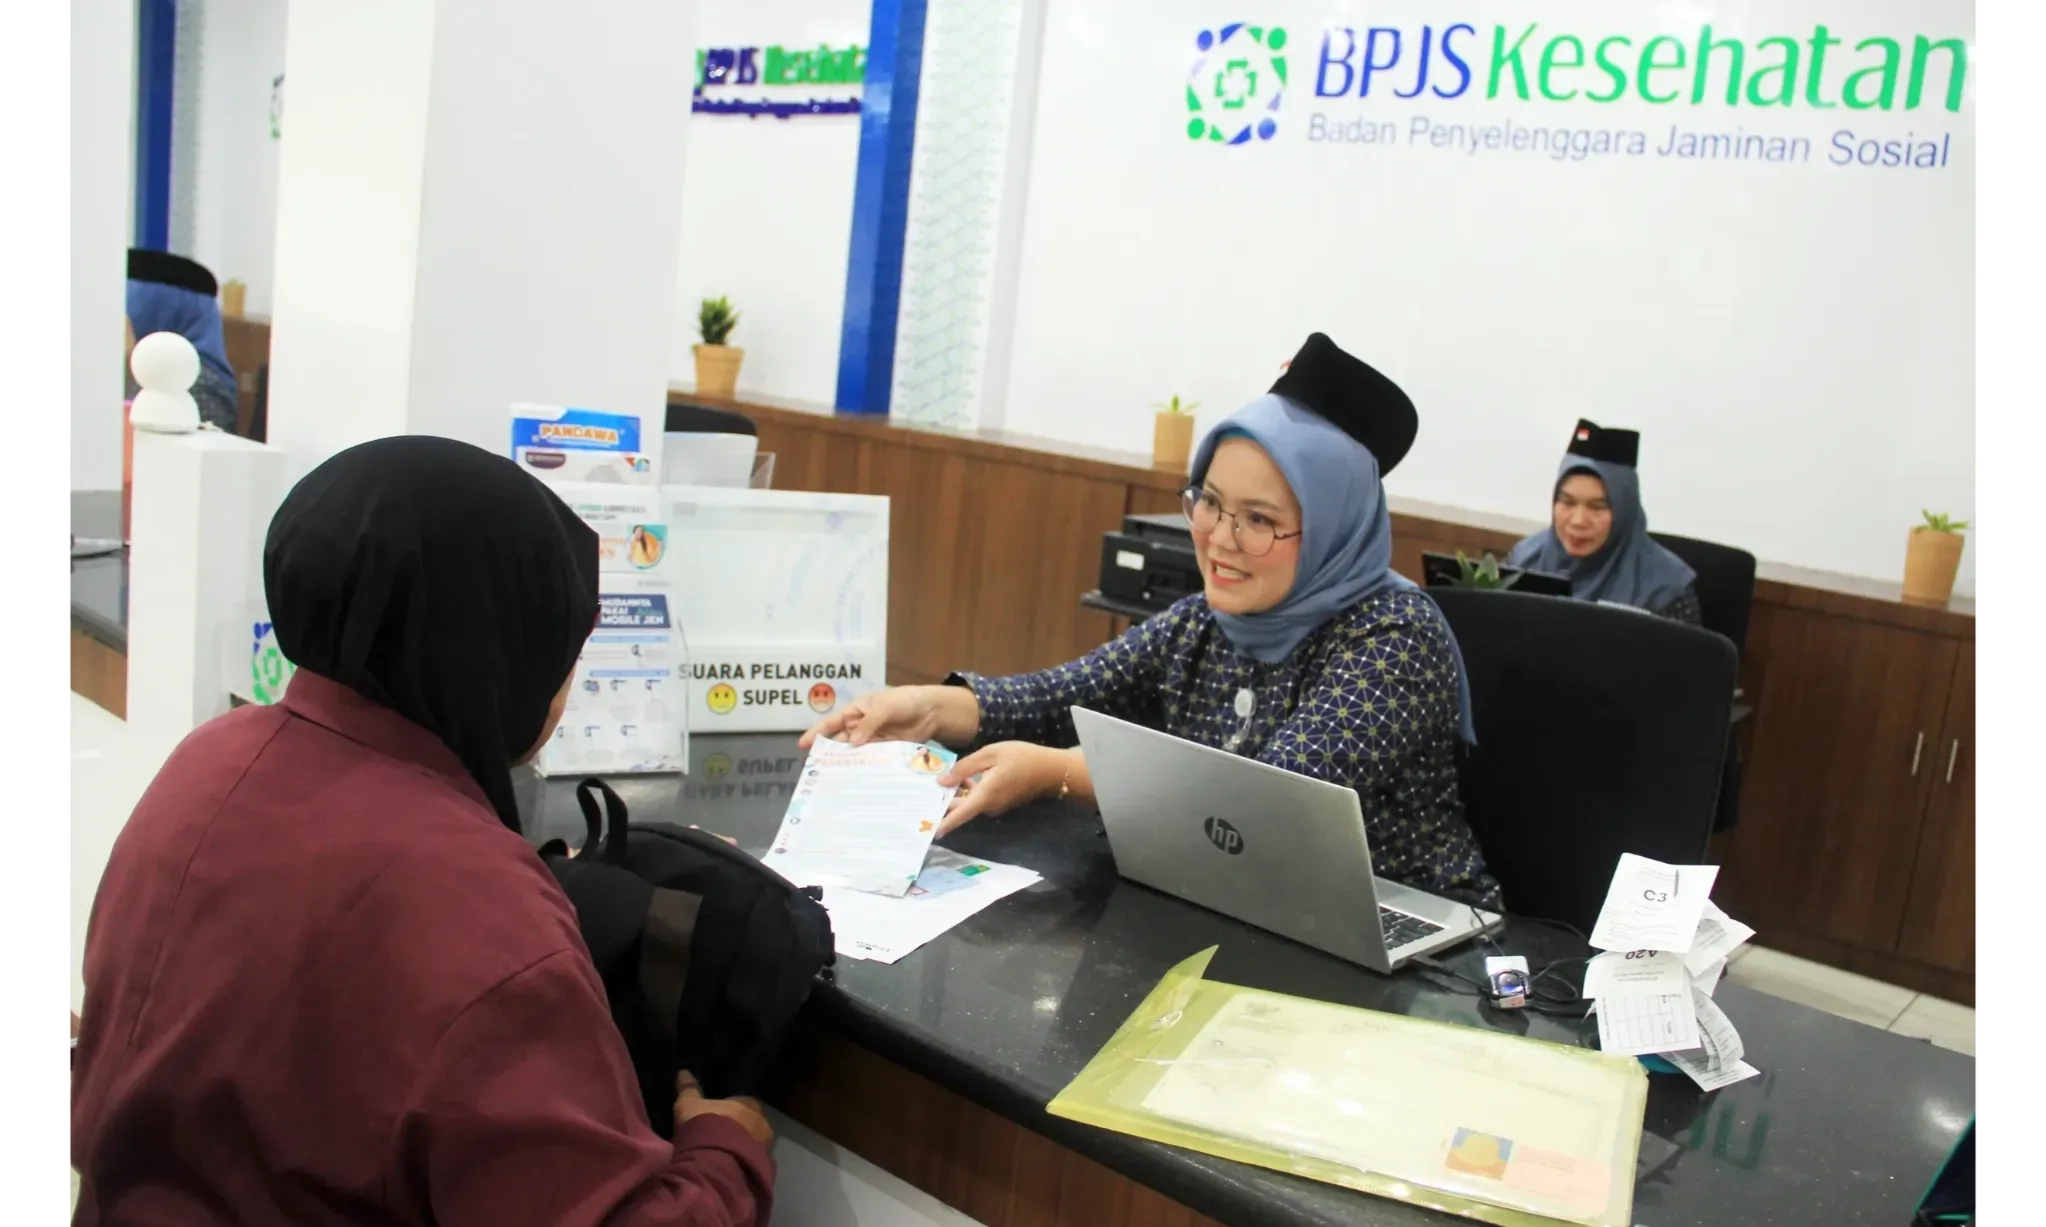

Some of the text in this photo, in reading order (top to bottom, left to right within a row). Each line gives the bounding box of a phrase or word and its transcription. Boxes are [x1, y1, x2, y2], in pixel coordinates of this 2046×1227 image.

[1315, 22, 1968, 112] BPJS Kesehatan
[1308, 113, 1950, 168] Badan Penyelenggara Jaminan Sosial
[540, 424, 619, 443] PANDAWA
[678, 664, 862, 680] SUARA PELANGGAN
[743, 690, 803, 705] SUPEL
[1207, 816, 1241, 854] hp
[1644, 889, 1668, 903] C3
